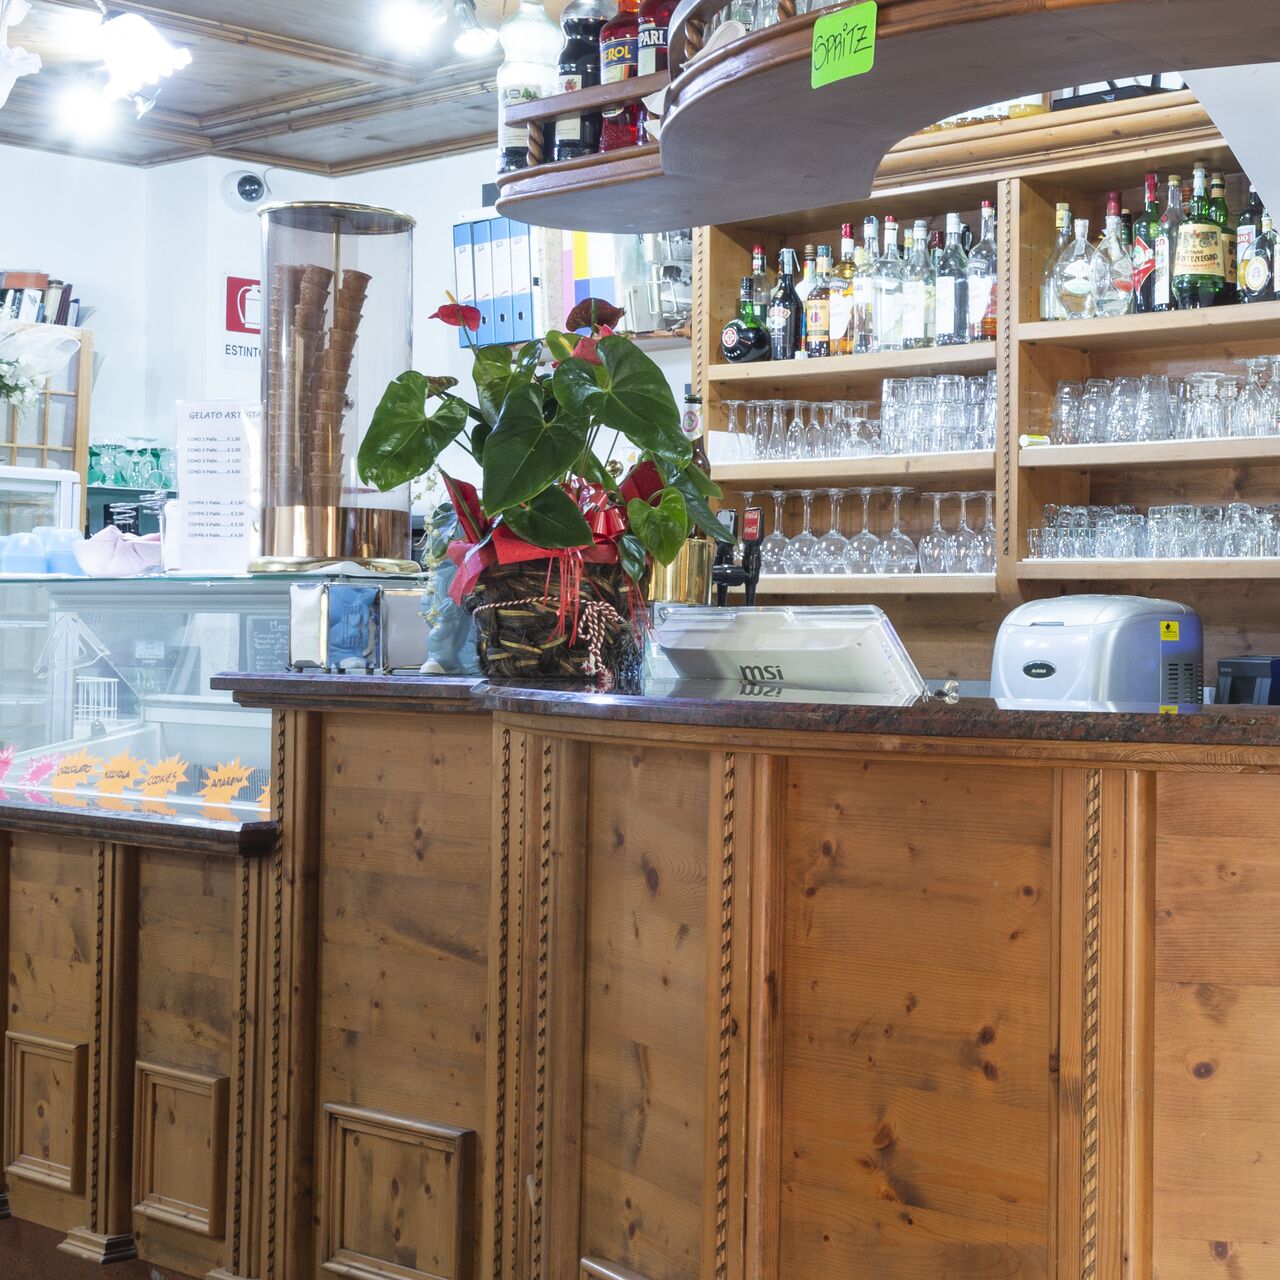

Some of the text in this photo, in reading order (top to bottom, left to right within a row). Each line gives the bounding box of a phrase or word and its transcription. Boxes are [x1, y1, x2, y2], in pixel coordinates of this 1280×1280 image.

[189, 411, 222, 420] GELATO
[738, 664, 784, 681] msi
[146, 771, 177, 786] COOKIES
